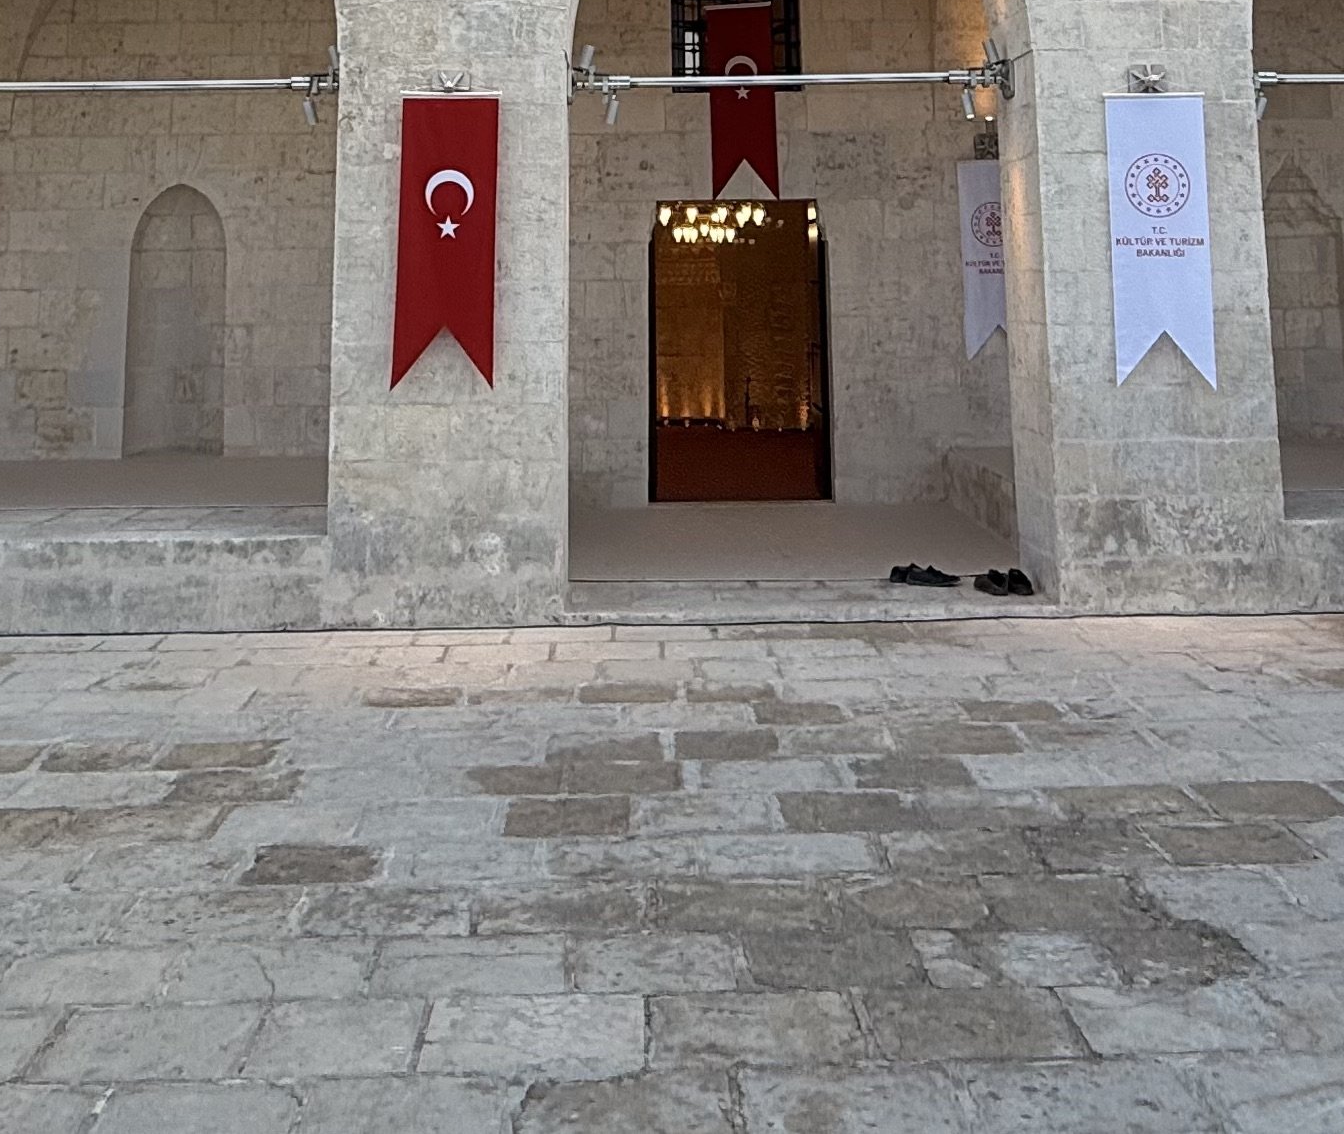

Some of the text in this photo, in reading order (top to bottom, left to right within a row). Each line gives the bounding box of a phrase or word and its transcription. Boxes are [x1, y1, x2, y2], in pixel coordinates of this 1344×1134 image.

[1152, 226, 1168, 234] T.C.
[1116, 236, 1205, 246] KÜLTÜR VE TURİZM
[1136, 248, 1185, 257] BAKANLIĞI
